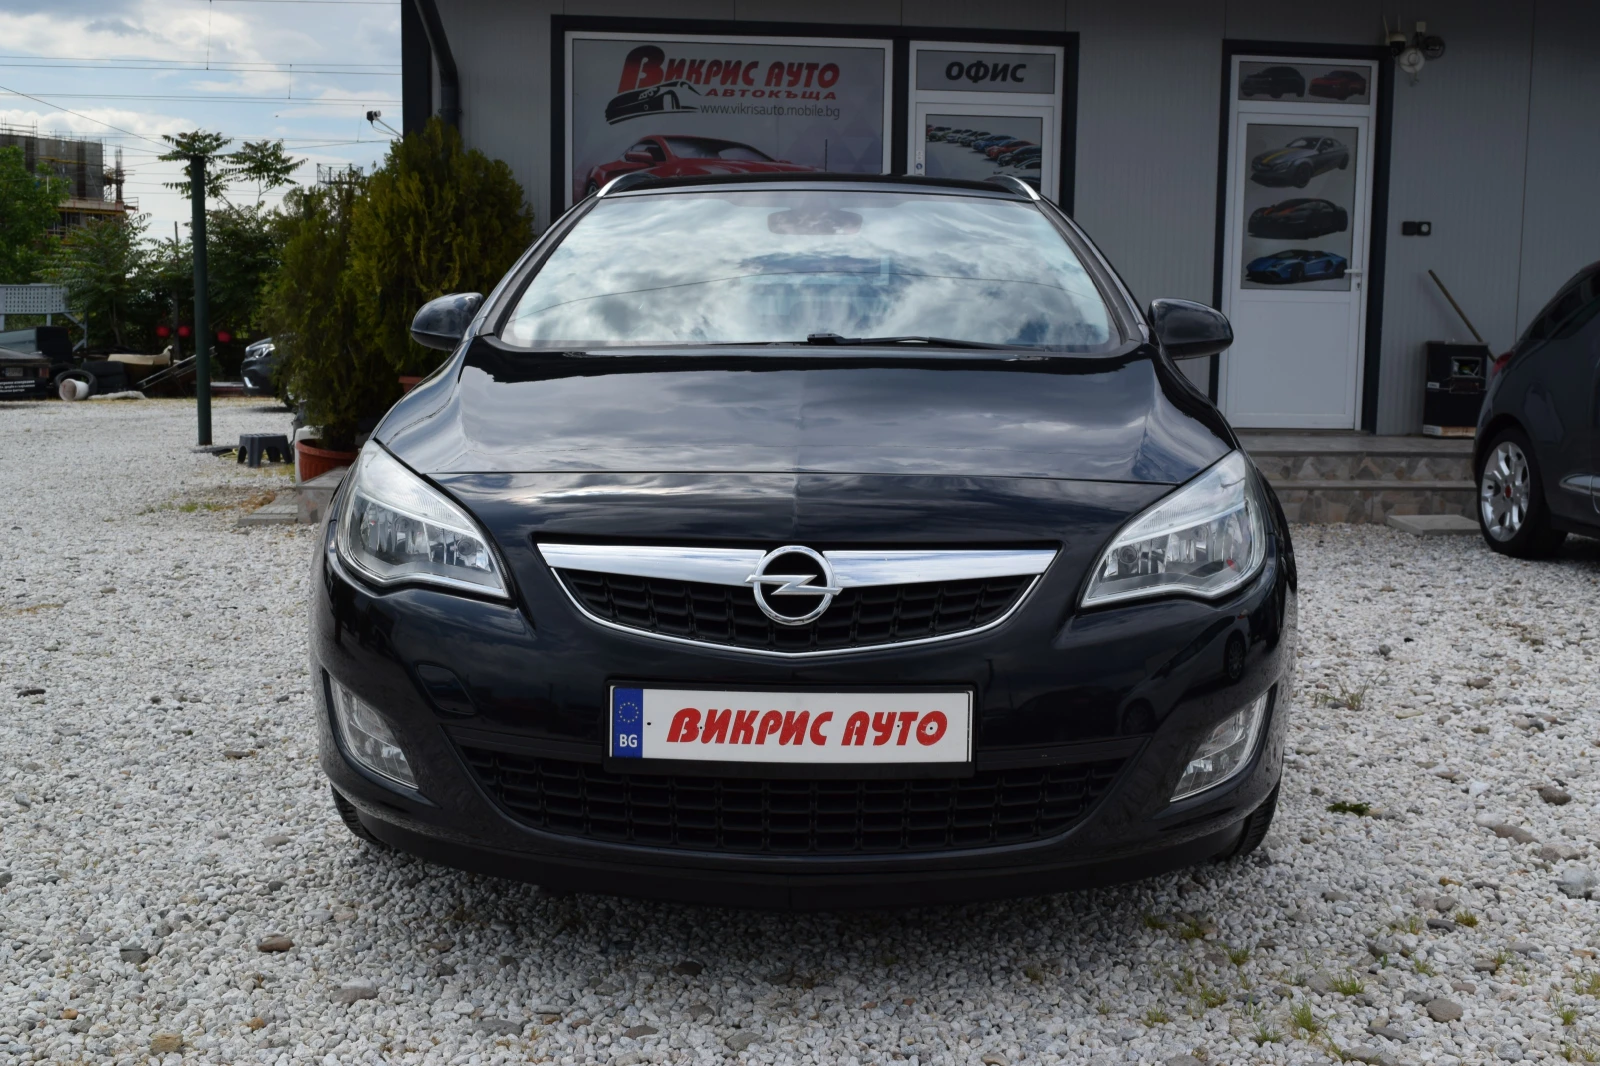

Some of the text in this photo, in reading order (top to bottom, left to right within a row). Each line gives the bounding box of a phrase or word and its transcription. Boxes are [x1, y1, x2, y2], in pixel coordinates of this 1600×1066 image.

[764, 61, 840, 88] АУТО
[945, 60, 1027, 83] ОФИС
[705, 88, 837, 101] АВТОКЪЩА
[700, 102, 840, 120] www.vikrisauto.mobile.bg
[666, 708, 948, 746] ВИКРИС АУТО
[619, 733, 638, 748] BG
